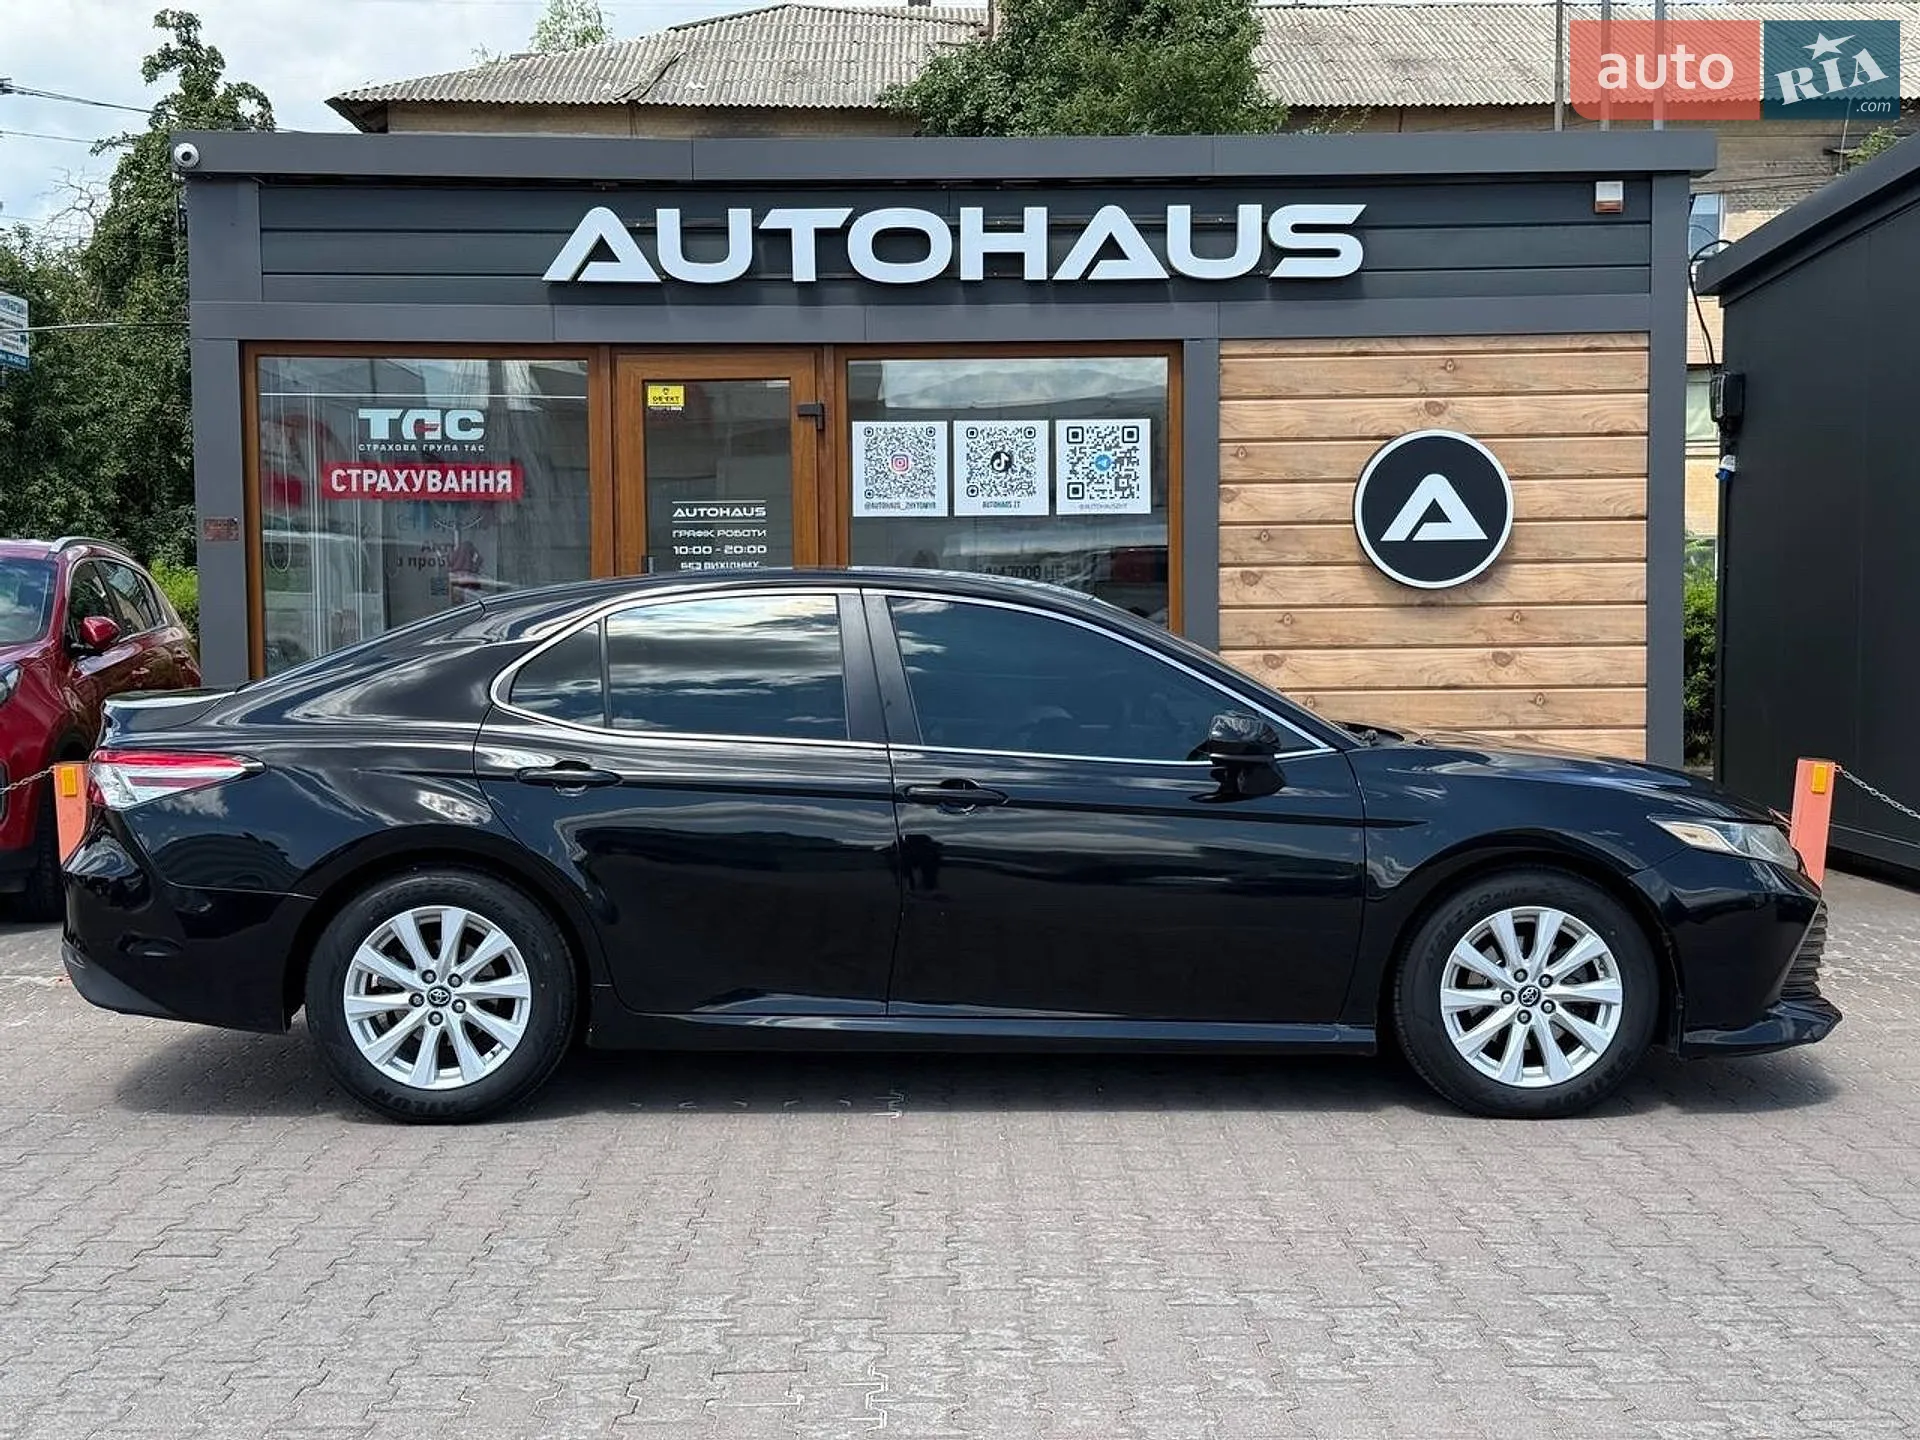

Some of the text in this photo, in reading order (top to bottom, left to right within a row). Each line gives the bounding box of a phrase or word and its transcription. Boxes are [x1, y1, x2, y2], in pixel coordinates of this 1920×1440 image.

[542, 204, 1366, 283] AUTOHAUS
[358, 443, 485, 452] СТРАХОВА ГРУПА ТАС
[331, 469, 513, 494] СТРАХУВАННЯ
[672, 507, 767, 518] AUTOHAUS
[1380, 473, 1489, 542] A
[673, 545, 713, 555] 10:00
[724, 545, 767, 555] 20:00
